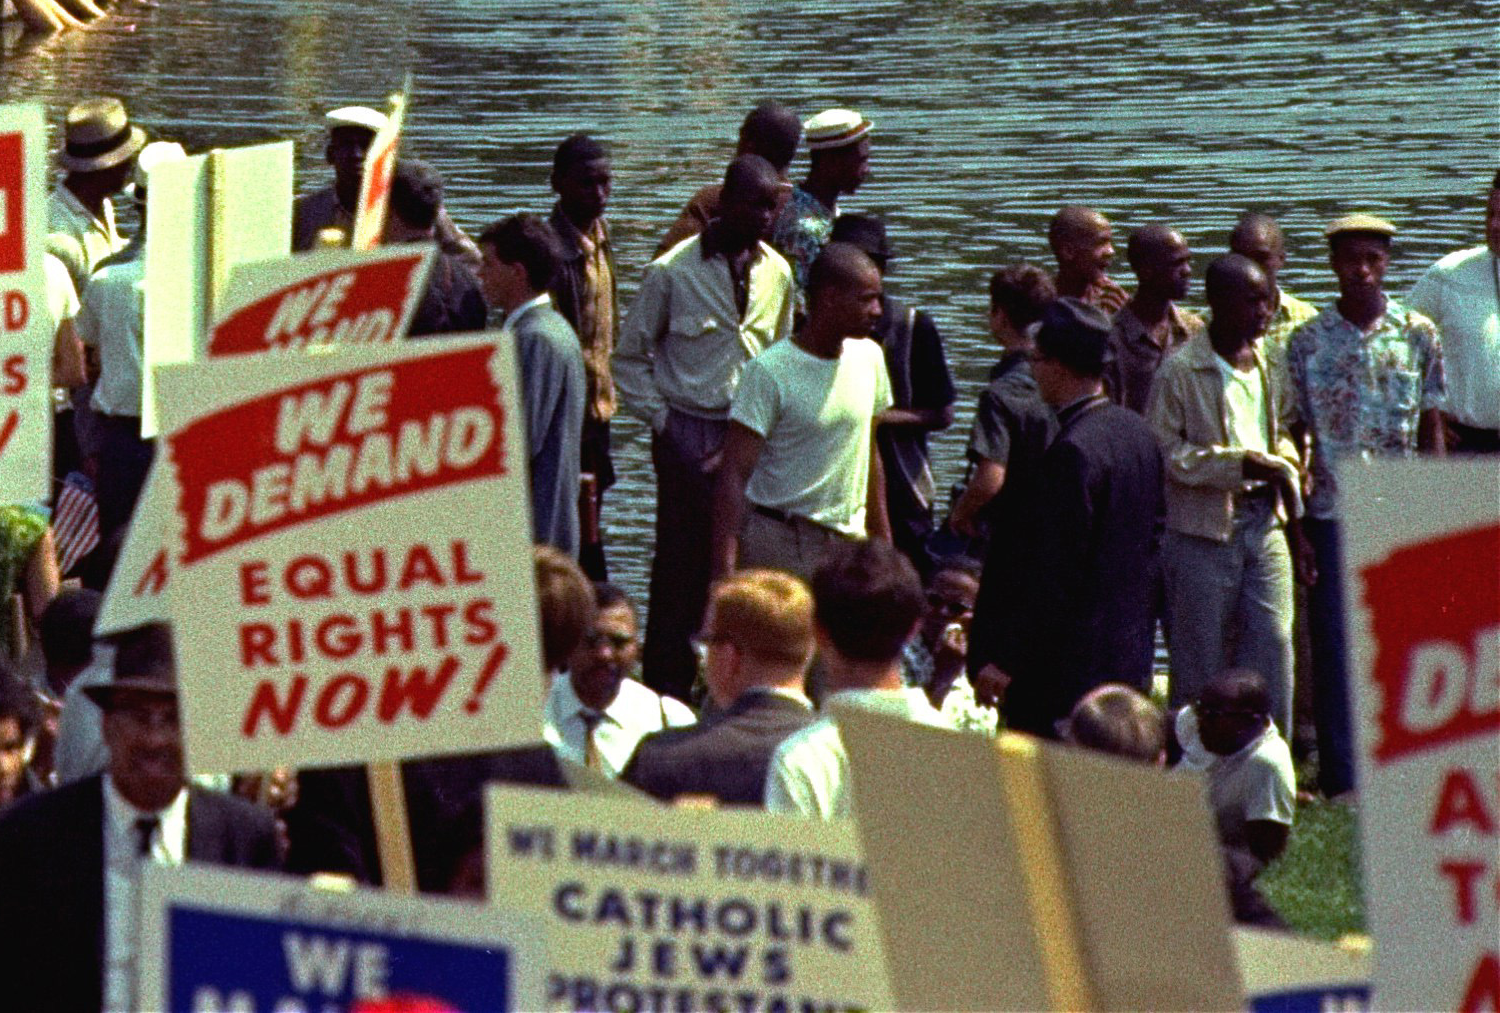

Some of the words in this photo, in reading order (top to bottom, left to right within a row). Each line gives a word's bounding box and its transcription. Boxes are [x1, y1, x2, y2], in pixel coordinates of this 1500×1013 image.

[264, 272, 359, 341] WE
[275, 368, 395, 456] WE
[199, 405, 497, 543] DEMAND
[239, 539, 486, 609] EQUAL
[239, 597, 500, 669] RIGHTS
[241, 641, 511, 739] NOW!
[569, 829, 698, 877] MARCH
[552, 880, 853, 954] CATHOLIC
[282, 930, 392, 1008] WE
[609, 937, 793, 987] JEWS
